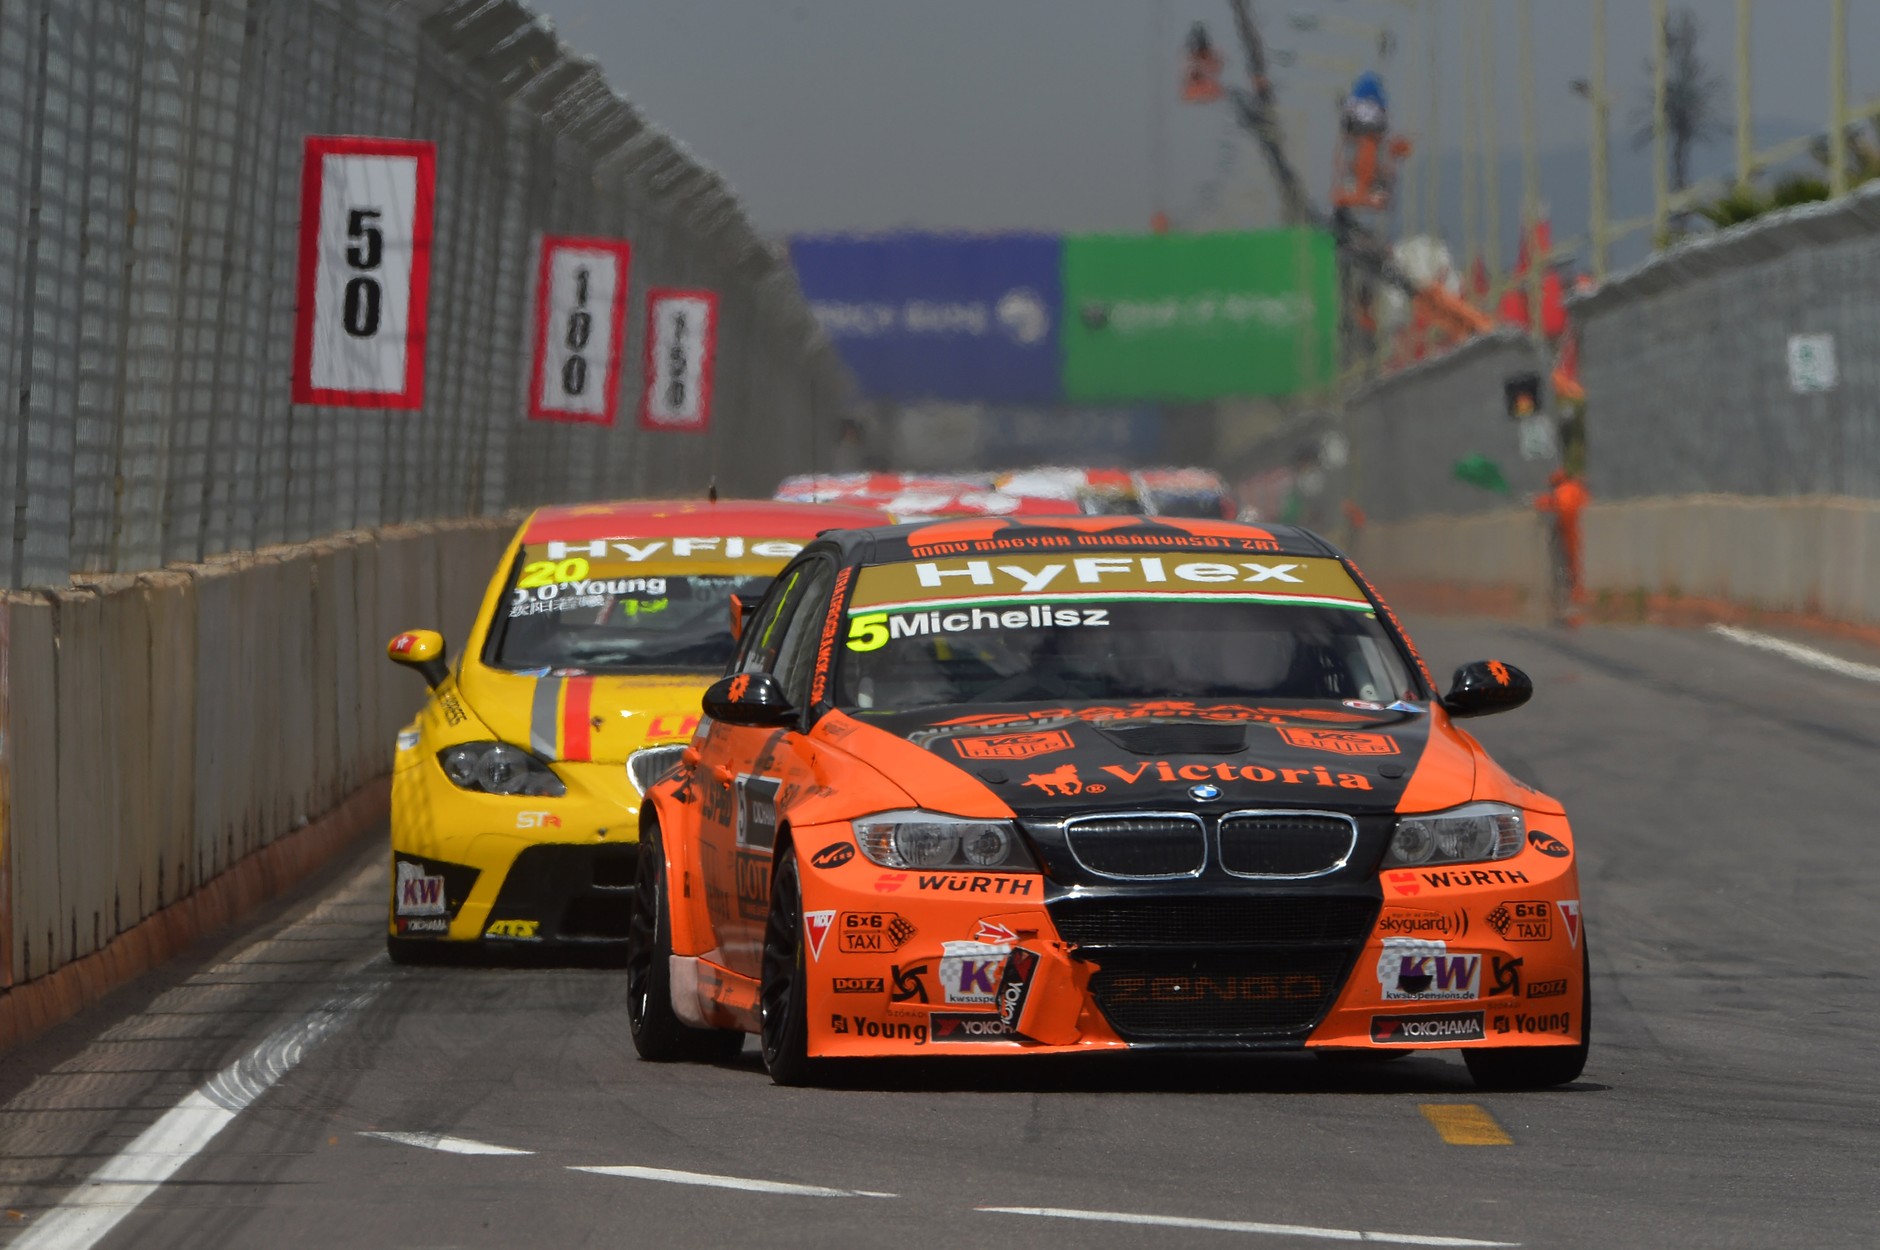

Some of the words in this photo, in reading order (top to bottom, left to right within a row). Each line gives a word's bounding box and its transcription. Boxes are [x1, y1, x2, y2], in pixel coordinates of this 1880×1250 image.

[342, 205, 383, 337] 50
[562, 267, 591, 396] 100
[976, 534, 1071, 552] MAGYAR
[518, 557, 590, 589] 20
[914, 557, 1305, 592] HyFlex
[845, 612, 891, 654] 5
[889, 606, 1110, 639] Michelisz
[1100, 761, 1374, 791] Victoria
[403, 878, 445, 906] KW
[1378, 915, 1446, 934] skyguard
[1516, 923, 1547, 938] TAXI
[845, 934, 882, 949] TAXI
[1395, 955, 1480, 992] KW
[853, 1016, 928, 1046] Young
[1401, 1018, 1481, 1037] YOKOHAMA
[1515, 1011, 1571, 1034] Young
